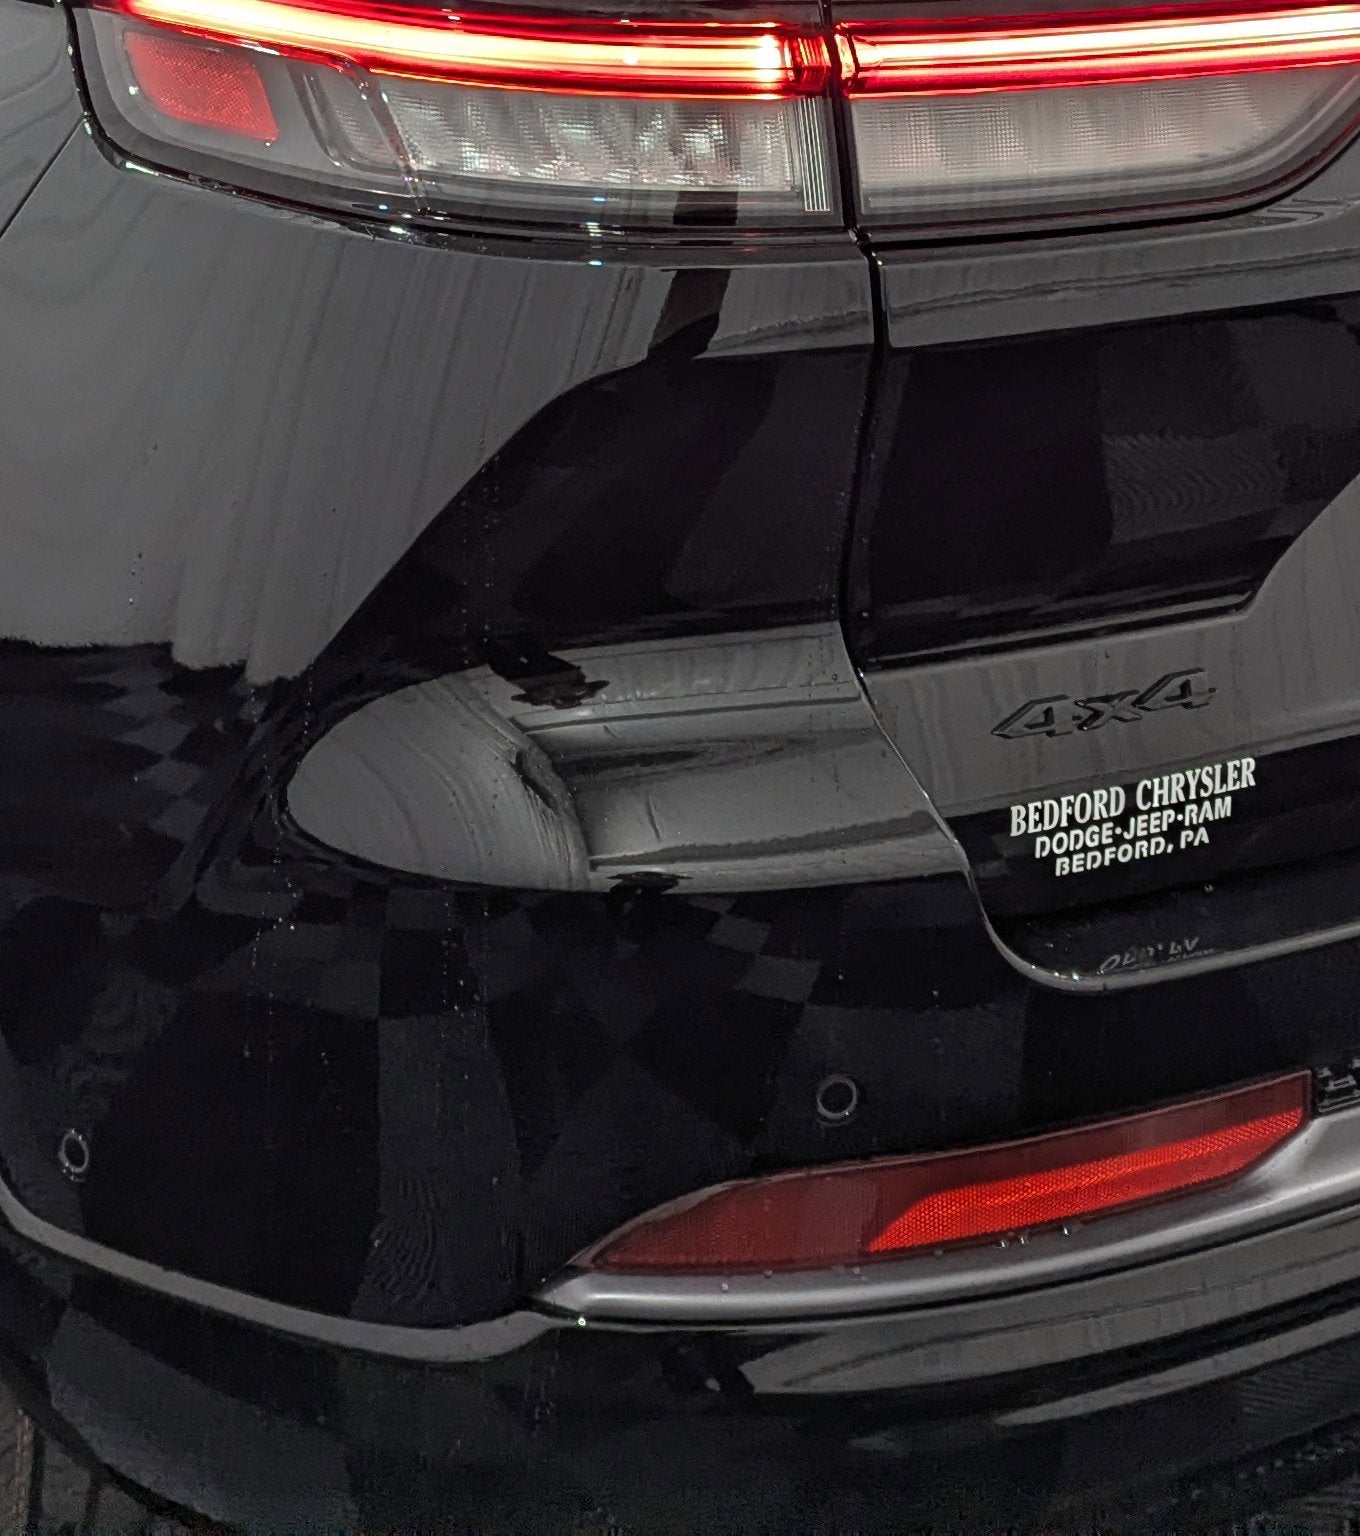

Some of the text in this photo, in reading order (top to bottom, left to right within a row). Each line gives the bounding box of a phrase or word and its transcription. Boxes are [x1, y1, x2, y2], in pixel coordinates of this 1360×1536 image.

[1010, 757, 1256, 837] BEDFORD CHRYSLER
[1180, 826, 1210, 849] PA
